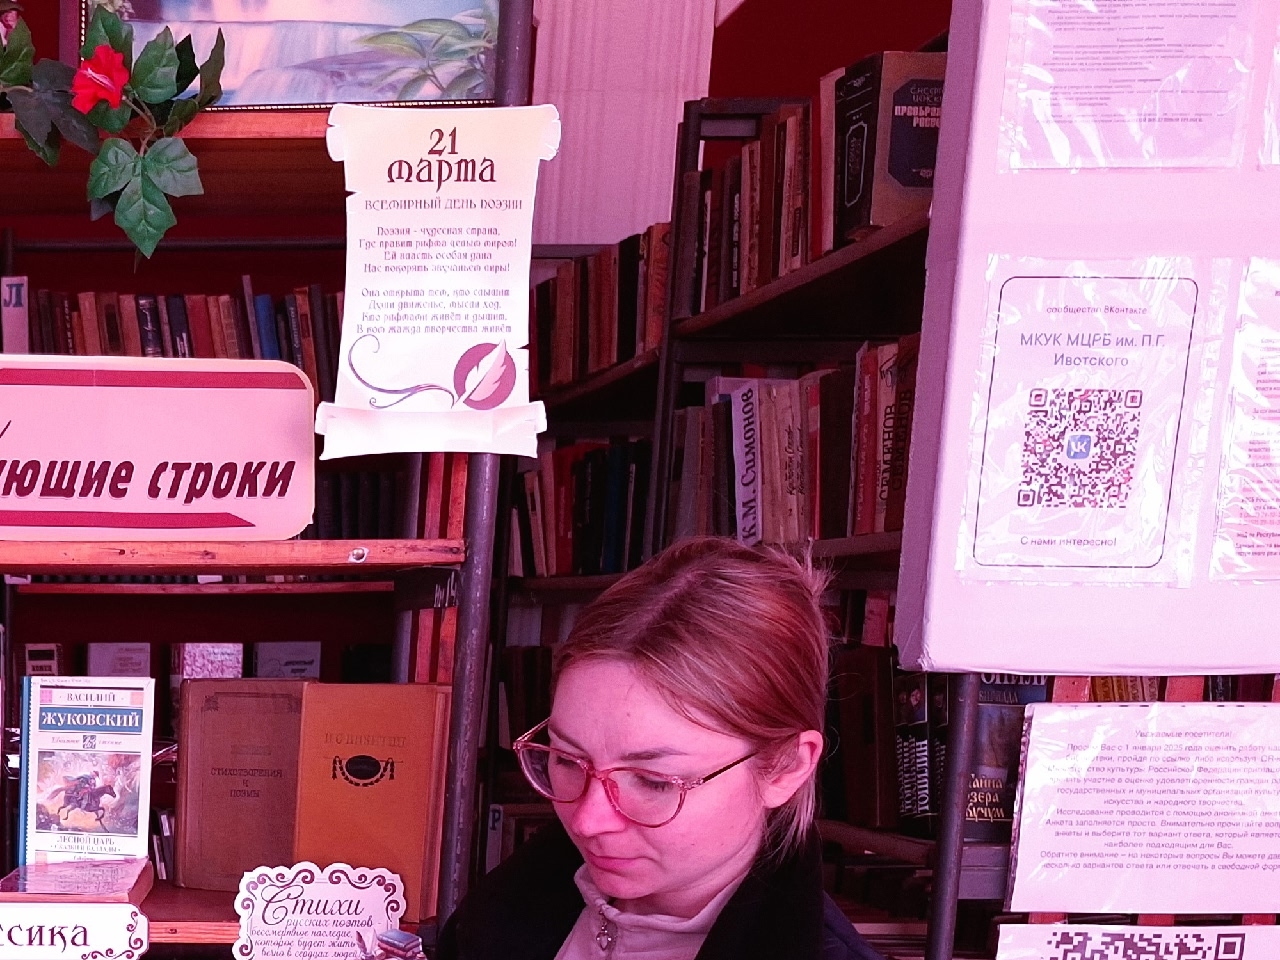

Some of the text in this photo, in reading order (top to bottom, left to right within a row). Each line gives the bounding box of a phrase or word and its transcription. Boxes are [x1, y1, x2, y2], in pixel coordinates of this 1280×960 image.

[428, 127, 458, 157] 21
[387, 157, 497, 192] марта
[365, 197, 523, 212] ВСЕМИРНЫЙ ДЕНЬ ПОЭЗИИ
[377, 226, 411, 236] Поэзия
[1020, 332, 1166, 350] МКУК МЦРБ им. П.Г.
[1053, 352, 1129, 367] Ивотского
[147, 457, 296, 501] строки
[66, 691, 116, 702] ВАСИЛИЙ
[41, 711, 140, 728] ЖУКОВСКИЙ
[261, 884, 365, 926] Стихи
[286, 915, 373, 931] русских поэтов
